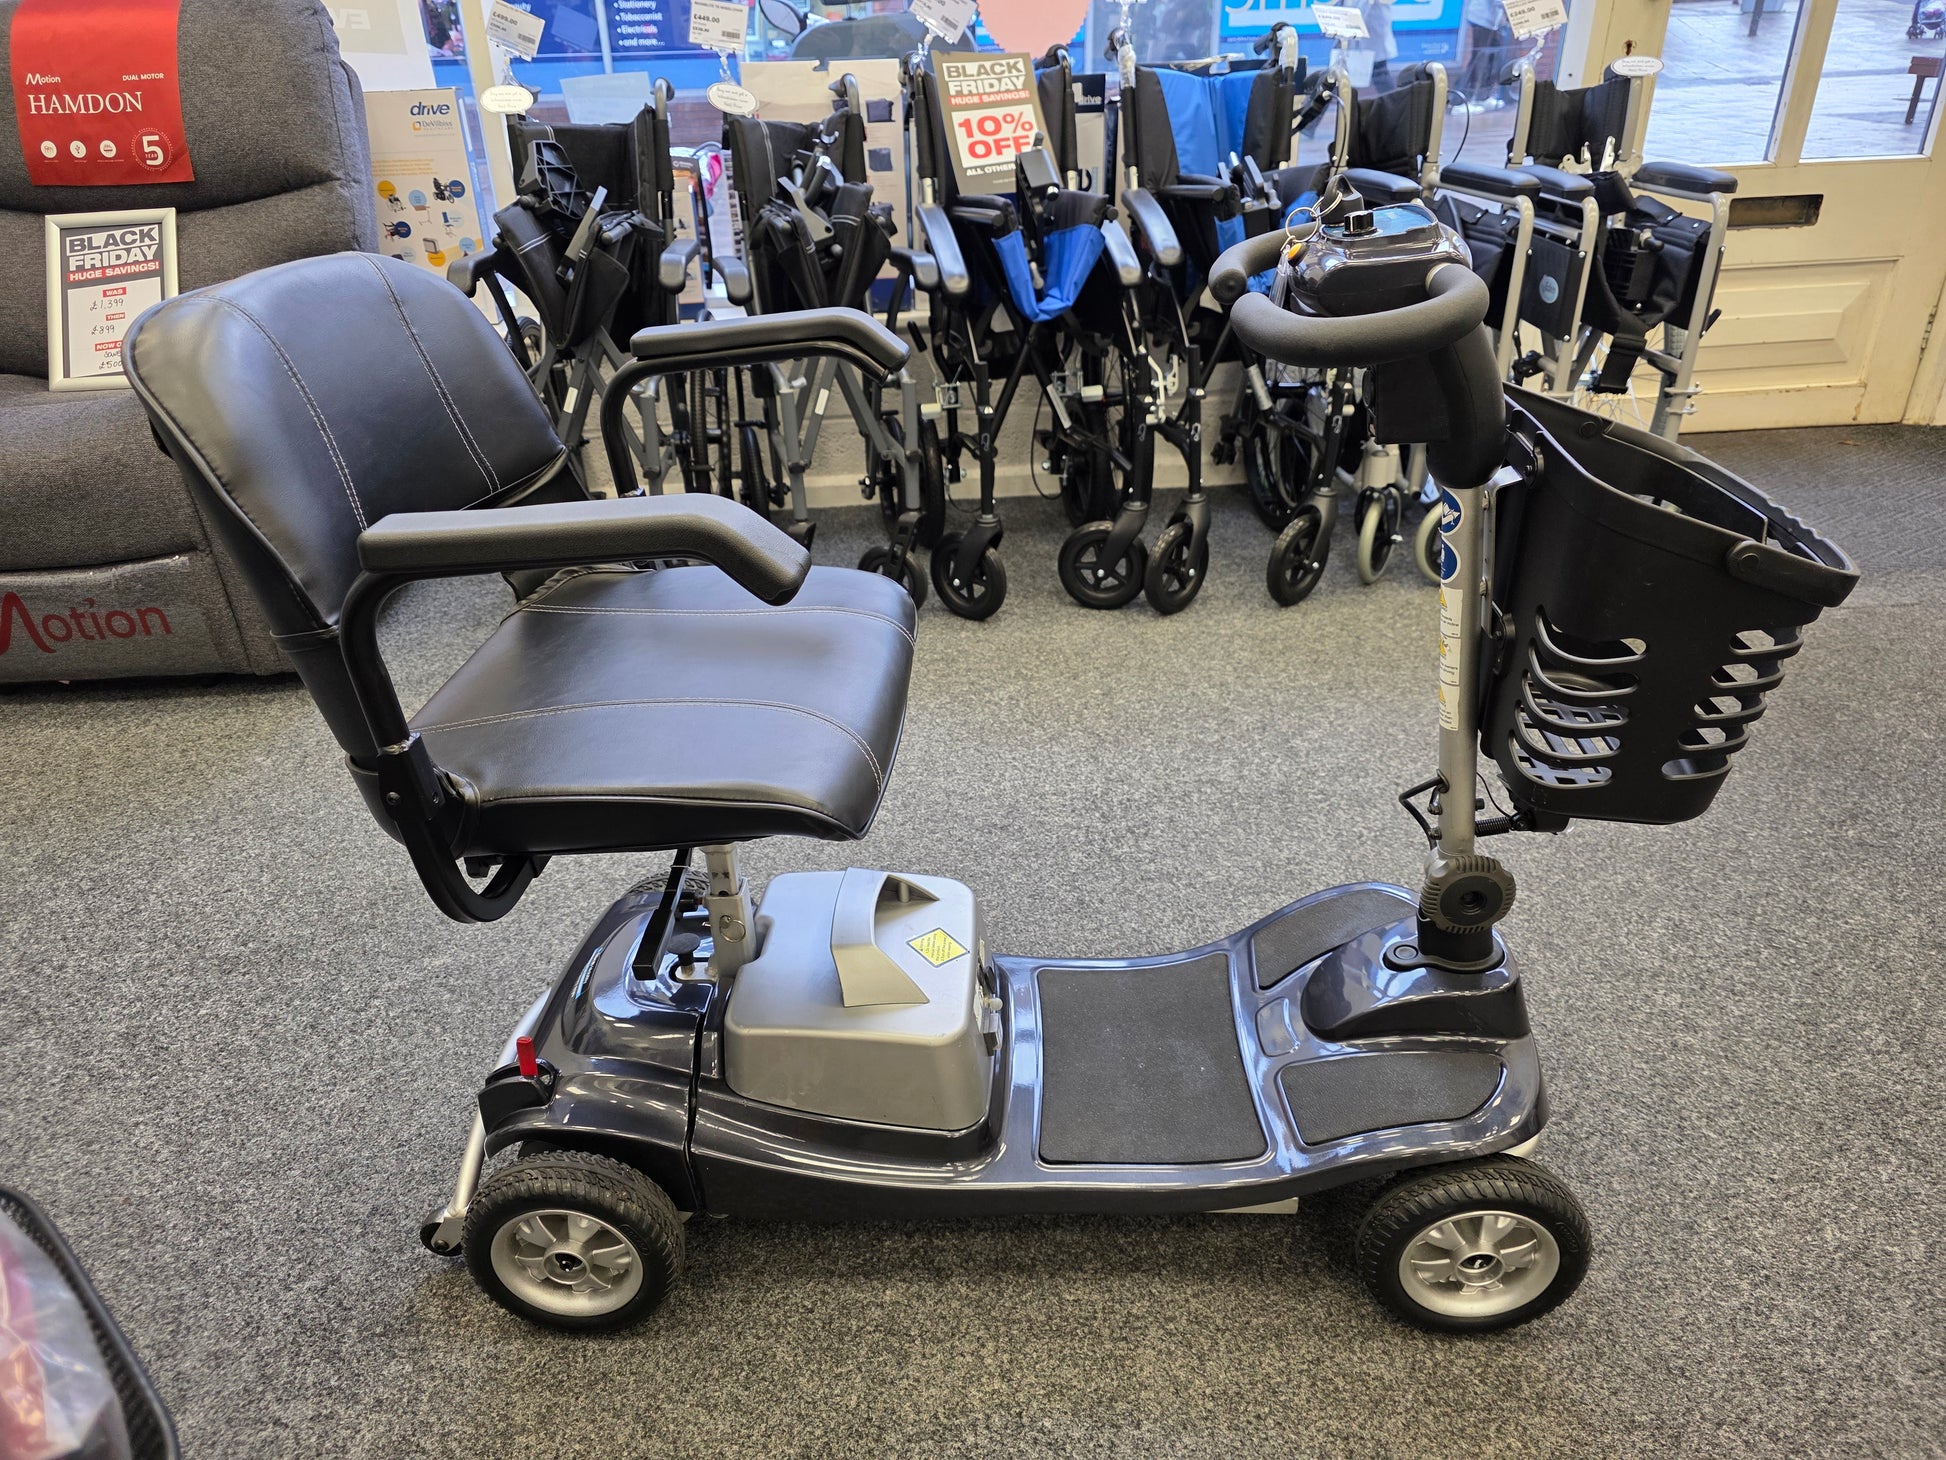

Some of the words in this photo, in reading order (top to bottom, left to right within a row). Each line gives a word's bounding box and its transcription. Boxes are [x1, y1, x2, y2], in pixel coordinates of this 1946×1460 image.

[26, 73, 61, 85] Motion
[946, 60, 1023, 79] BLACK
[947, 75, 1026, 96] FRIDAY
[27, 92, 143, 114] HAMDON
[951, 96, 981, 105] HUGE
[982, 90, 1030, 103] SAVINGS!
[410, 101, 450, 116] drive
[957, 111, 1034, 139] 10%
[142, 135, 164, 165] 5
[967, 134, 1031, 159] OFF
[966, 167, 985, 176] ALL
[68, 226, 158, 254] BLACK
[69, 244, 159, 271] FRIDAY
[70, 269, 103, 281] HUGE
[105, 261, 160, 277] SAVINGS!
[106, 289, 123, 297] WAS
[91, 324, 115, 335] £899
[96, 342, 115, 350] NOW
